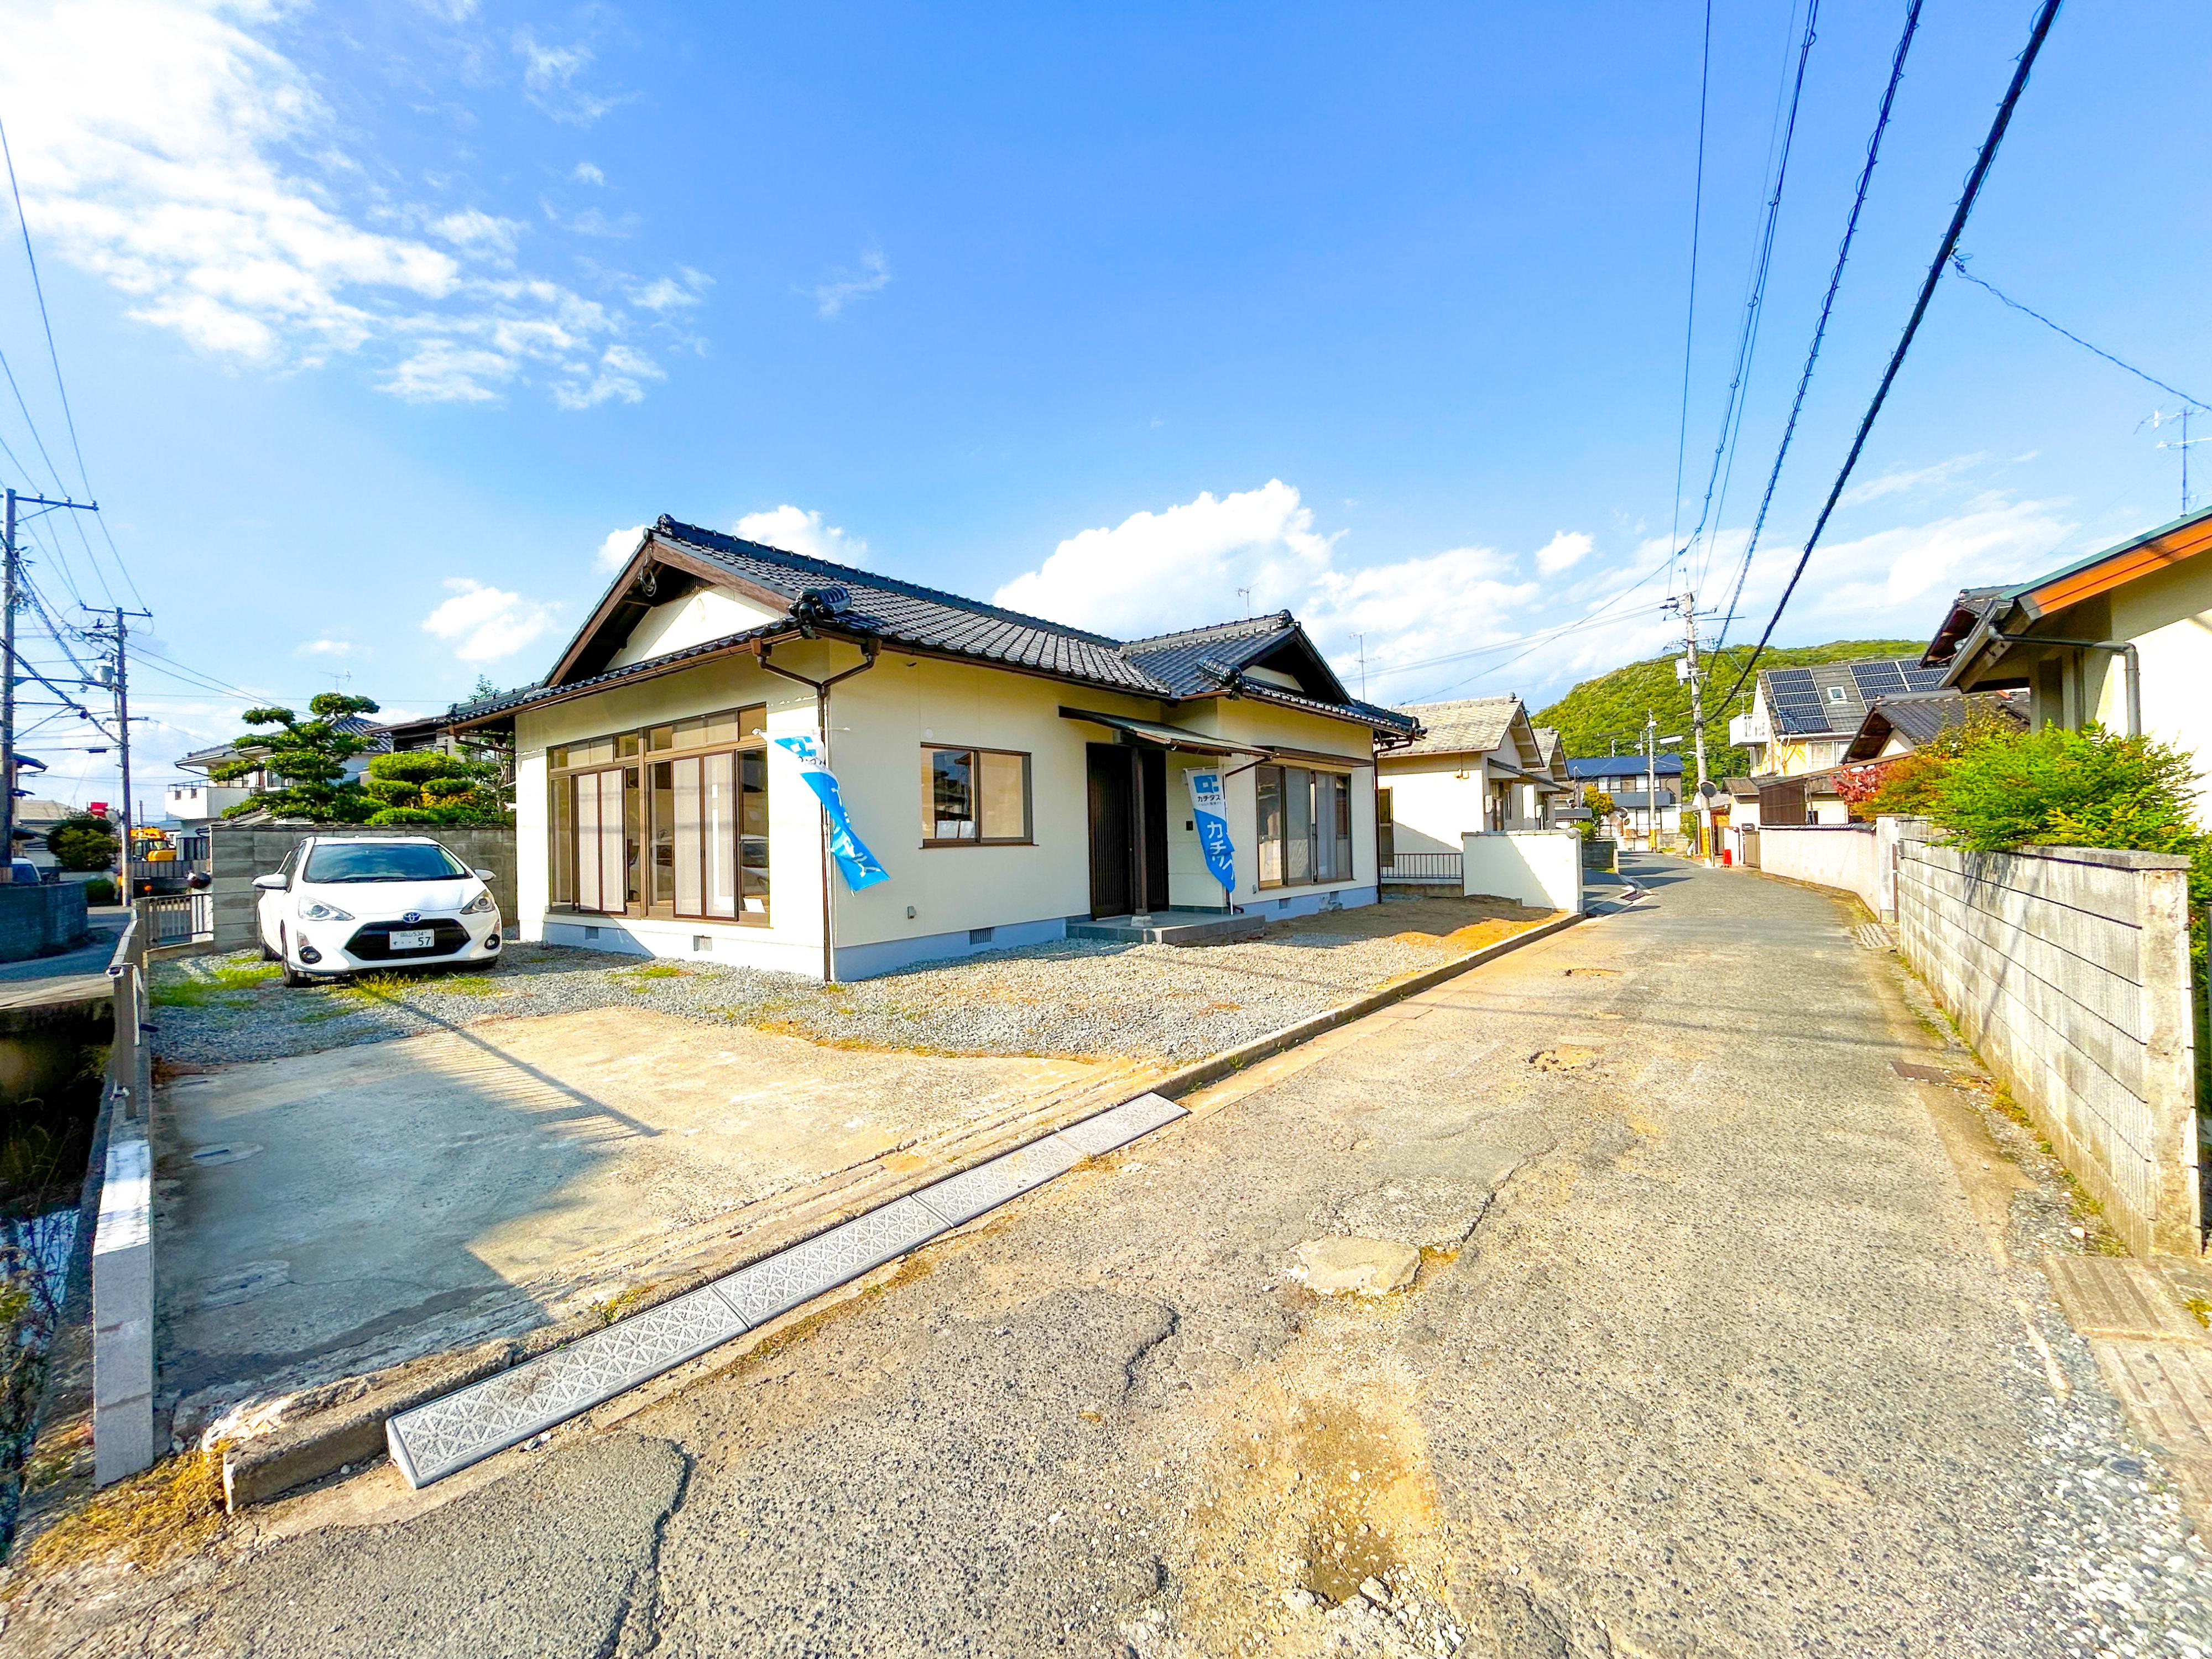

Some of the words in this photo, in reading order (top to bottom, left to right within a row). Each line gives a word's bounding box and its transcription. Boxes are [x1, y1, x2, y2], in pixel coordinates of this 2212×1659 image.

[1197, 794, 1220, 802] カチタス
[418, 936, 431, 946] 57
